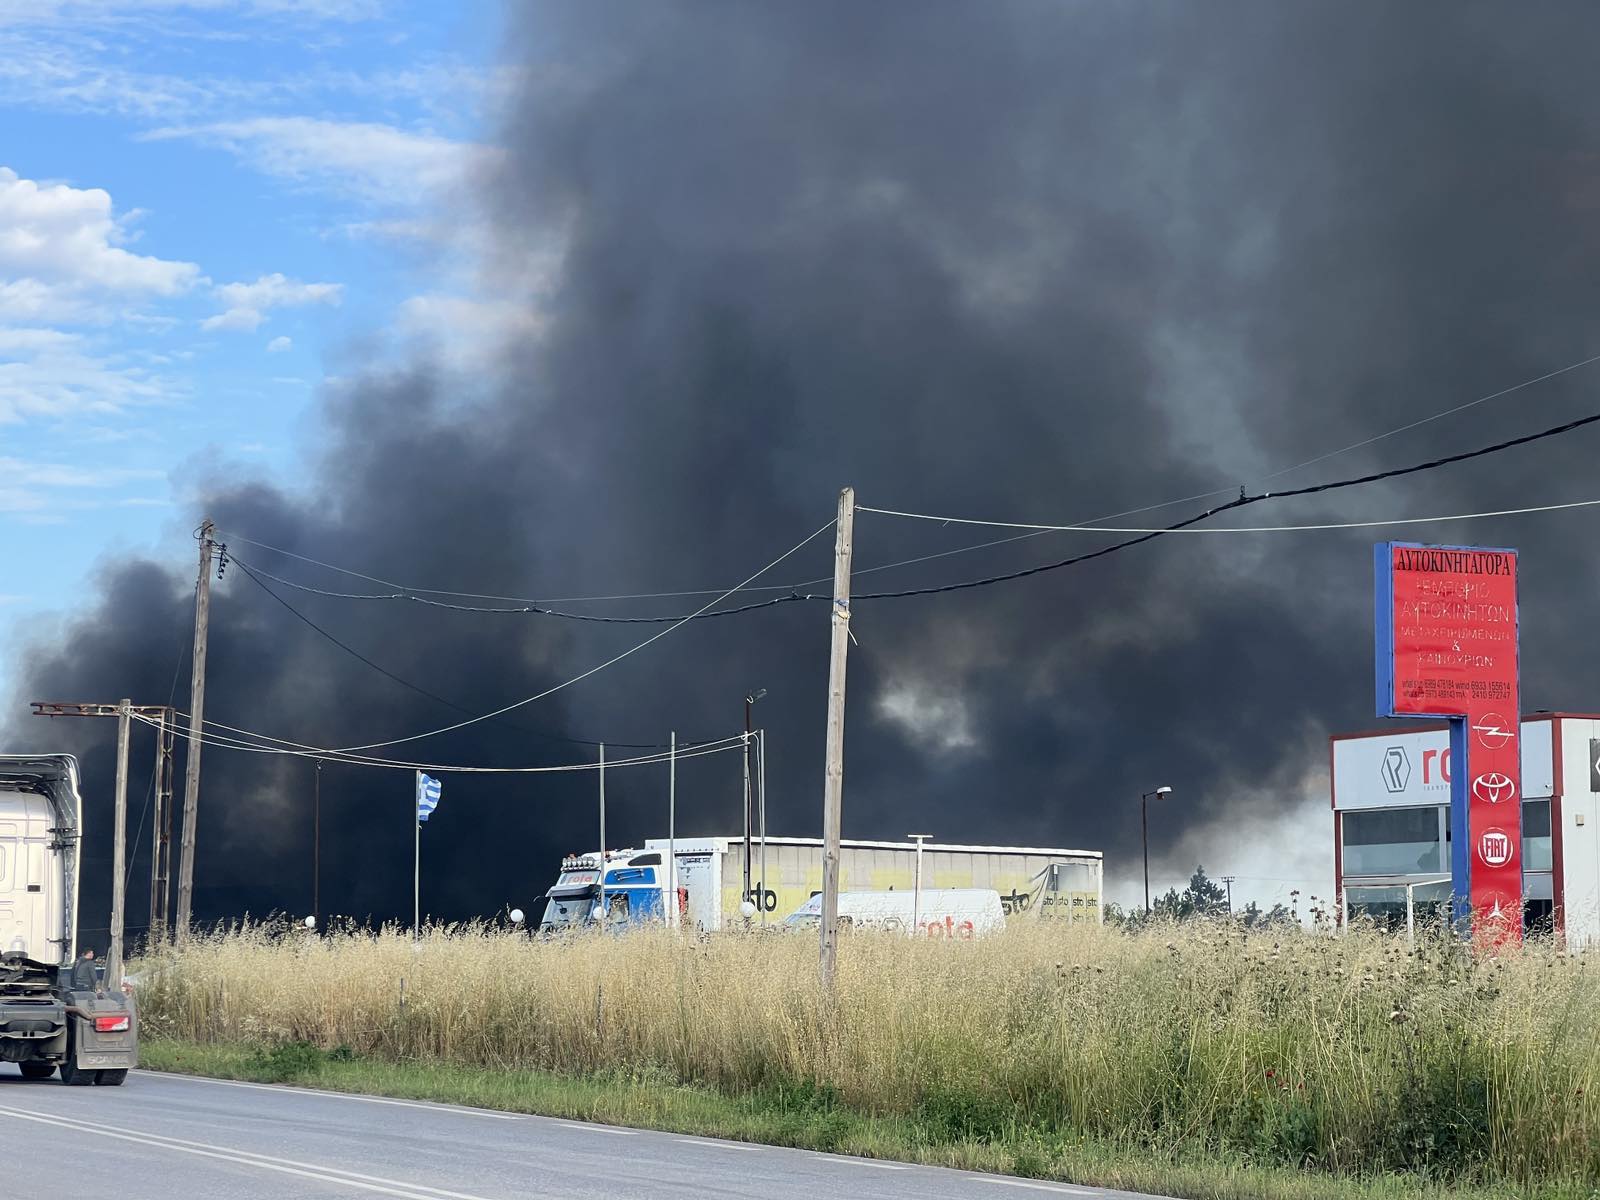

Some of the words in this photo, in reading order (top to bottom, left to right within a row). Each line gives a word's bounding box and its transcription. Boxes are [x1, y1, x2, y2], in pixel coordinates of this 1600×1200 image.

[1396, 550, 1511, 576] ΑΥΤΟΚΙΝΗΤΑΓΟΡΑ
[1401, 601, 1509, 622] ΑΥΤΟΚΙΝΗΤΩΝ
[1451, 640, 1461, 651] &
[1485, 837, 1507, 858] FIAT
[1072, 896, 1084, 908] sto
